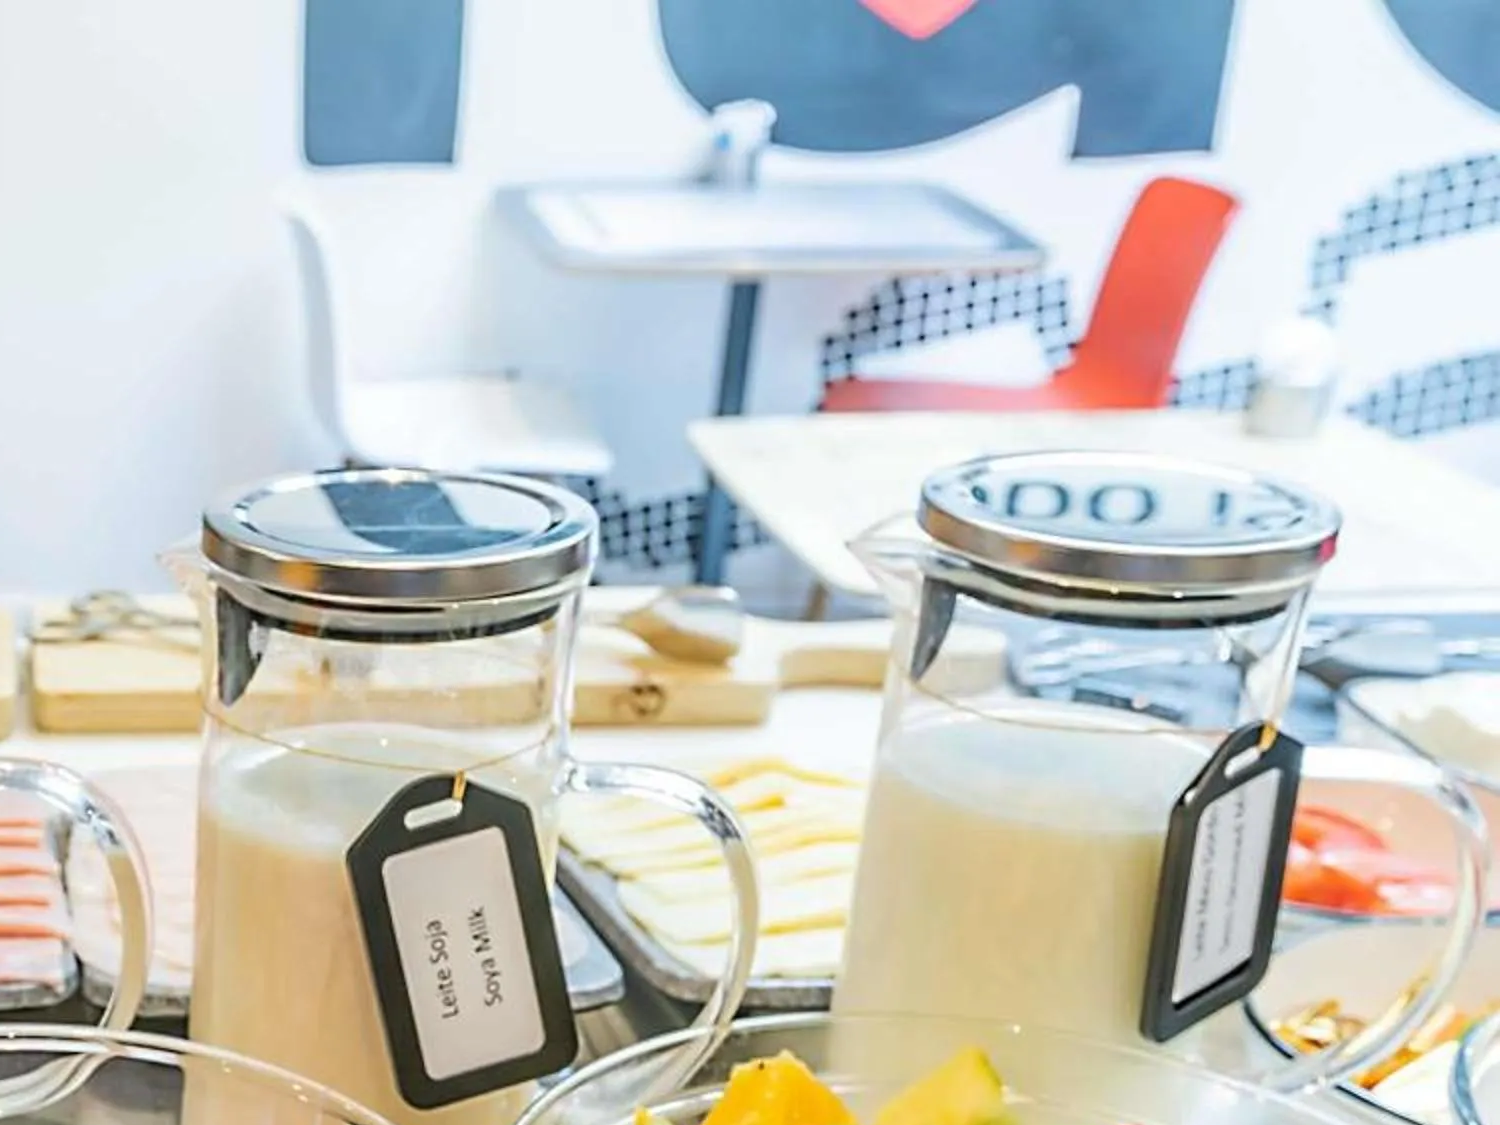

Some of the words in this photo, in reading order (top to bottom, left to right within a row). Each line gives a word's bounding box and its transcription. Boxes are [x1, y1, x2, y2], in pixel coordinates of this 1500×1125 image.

[425, 919, 450, 965] Soja
[467, 906, 492, 954] Milk
[438, 967, 460, 1019] Leite
[481, 958, 503, 1007] Soya
